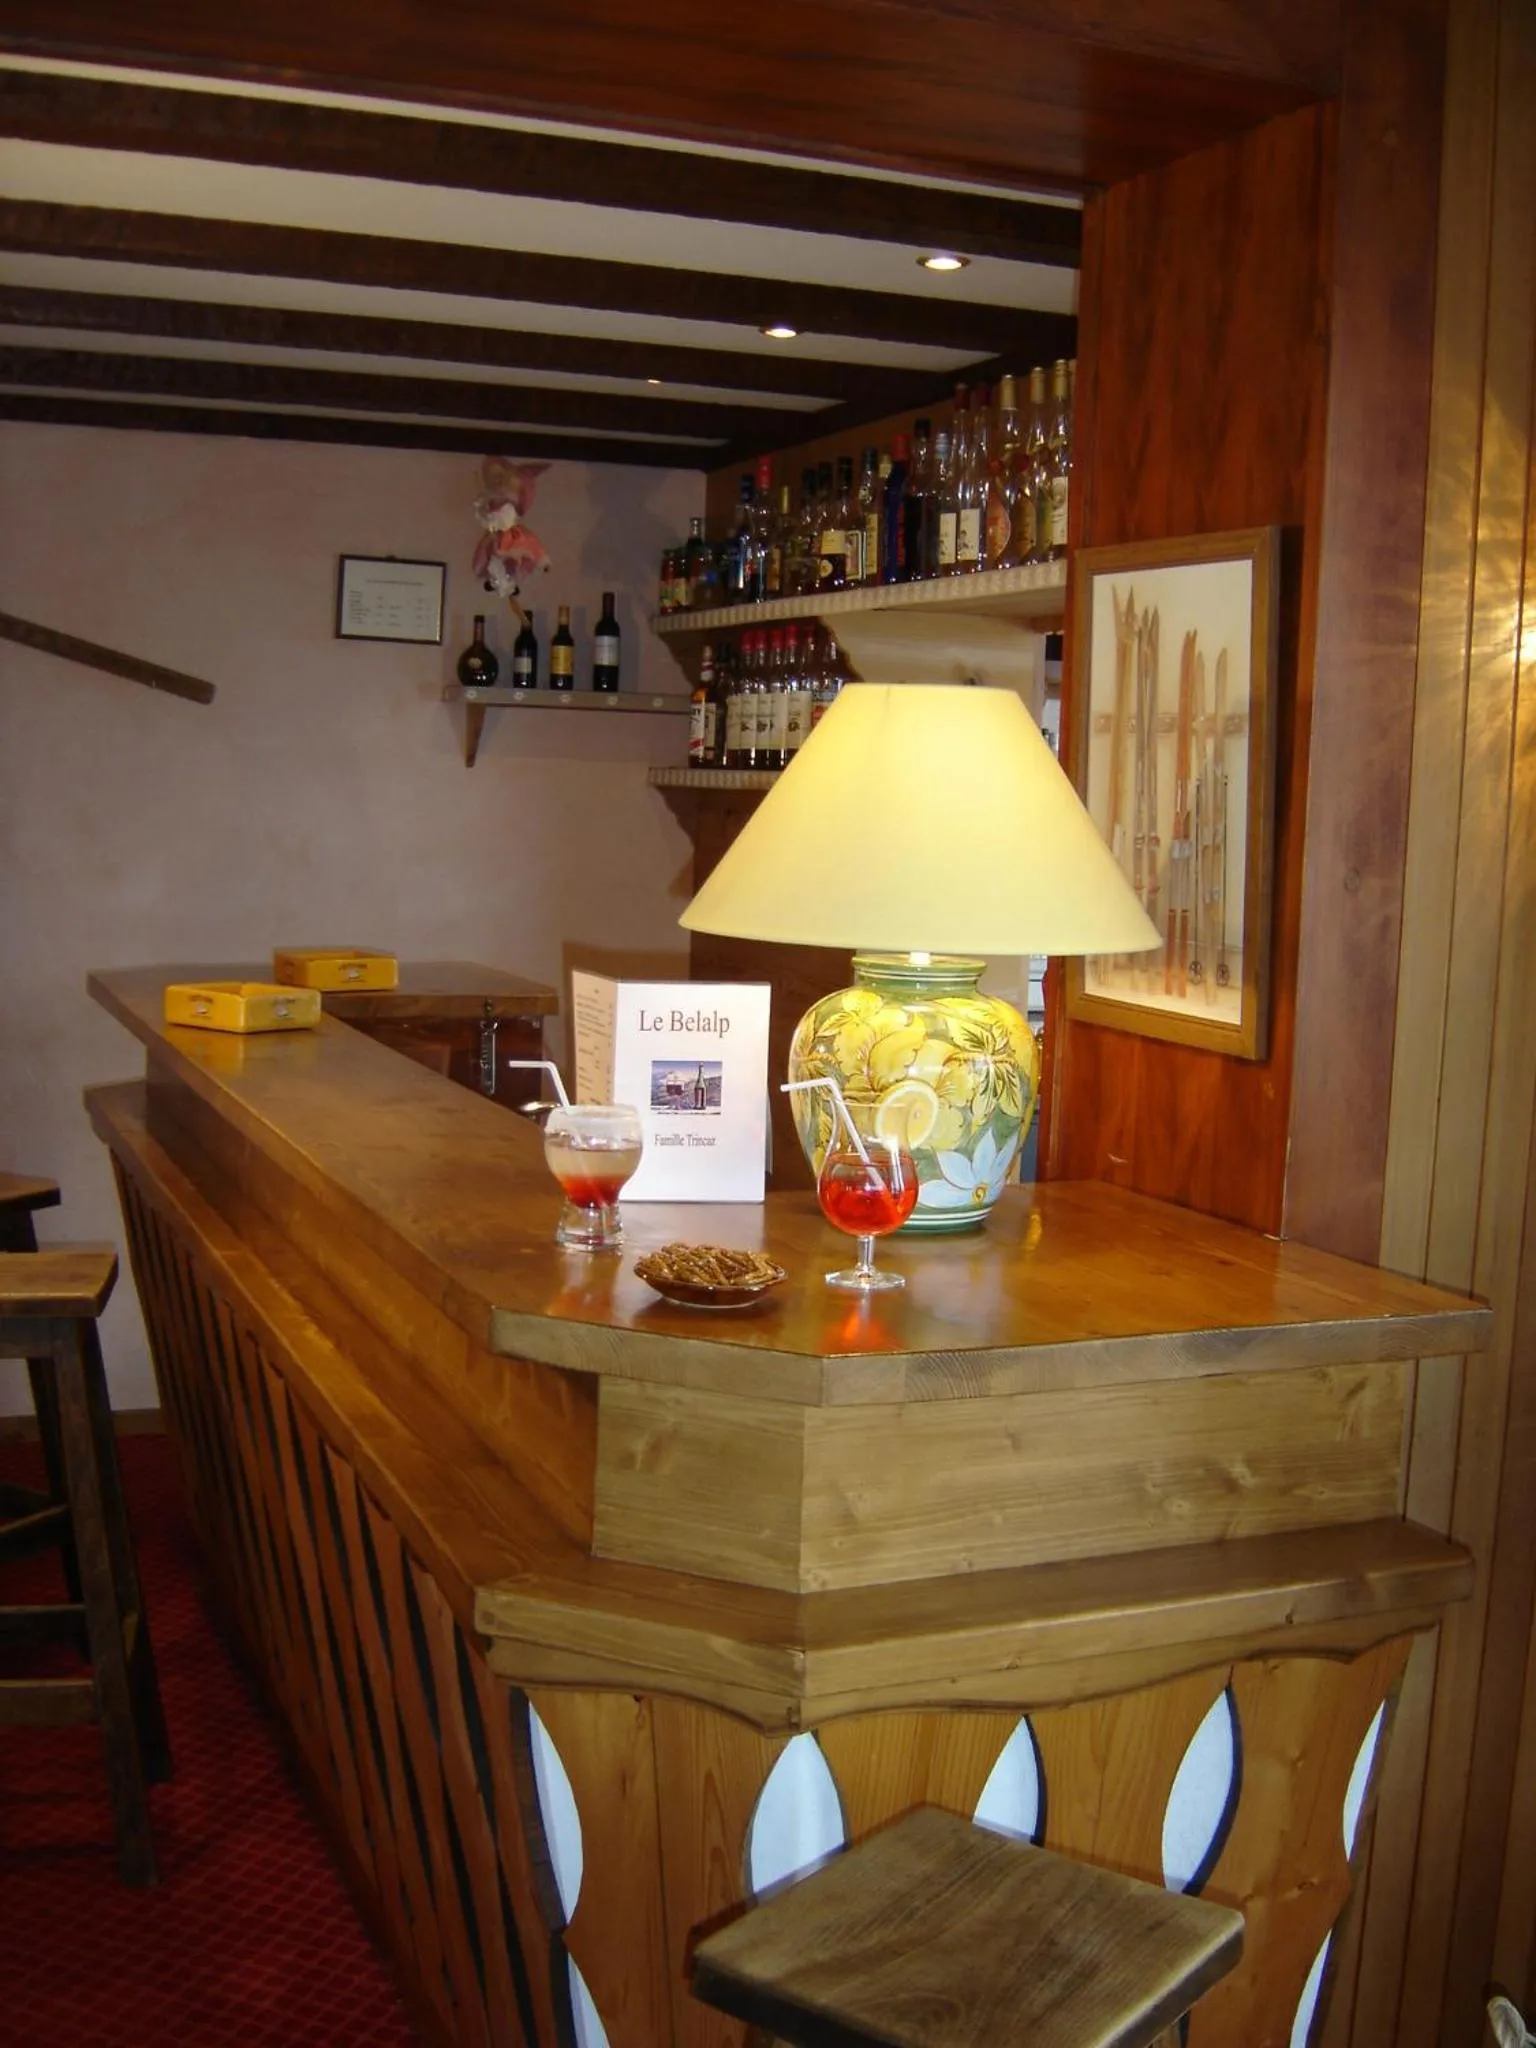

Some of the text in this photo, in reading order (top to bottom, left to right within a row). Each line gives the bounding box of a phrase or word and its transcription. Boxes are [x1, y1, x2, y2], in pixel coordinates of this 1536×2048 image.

[639, 1009, 730, 1038] Le Belalp
[654, 1133, 685, 1147] Famille
